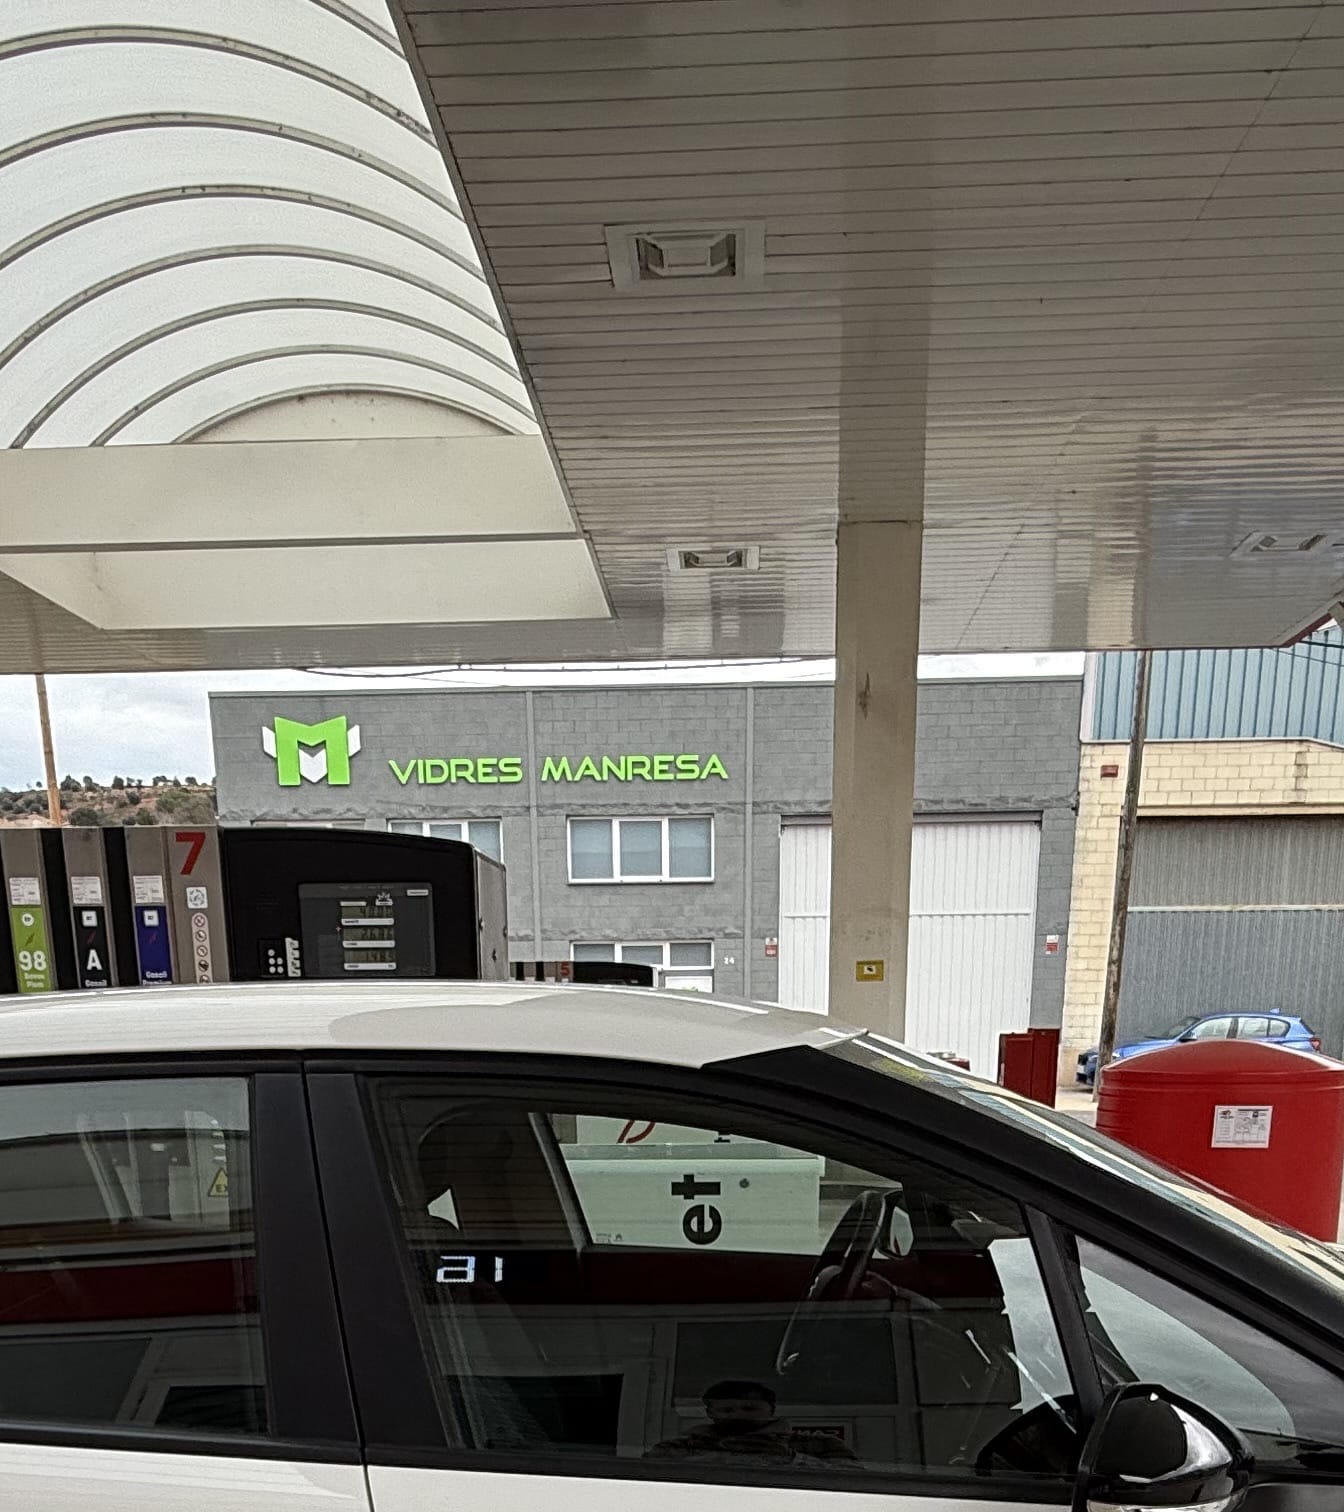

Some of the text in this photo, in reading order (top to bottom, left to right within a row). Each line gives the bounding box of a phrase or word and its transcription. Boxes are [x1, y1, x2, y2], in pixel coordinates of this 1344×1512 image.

[387, 753, 728, 785] VIDRES MANRESA
[175, 832, 206, 875] 7
[19, 950, 47, 971] 98
[86, 949, 103, 971] A
